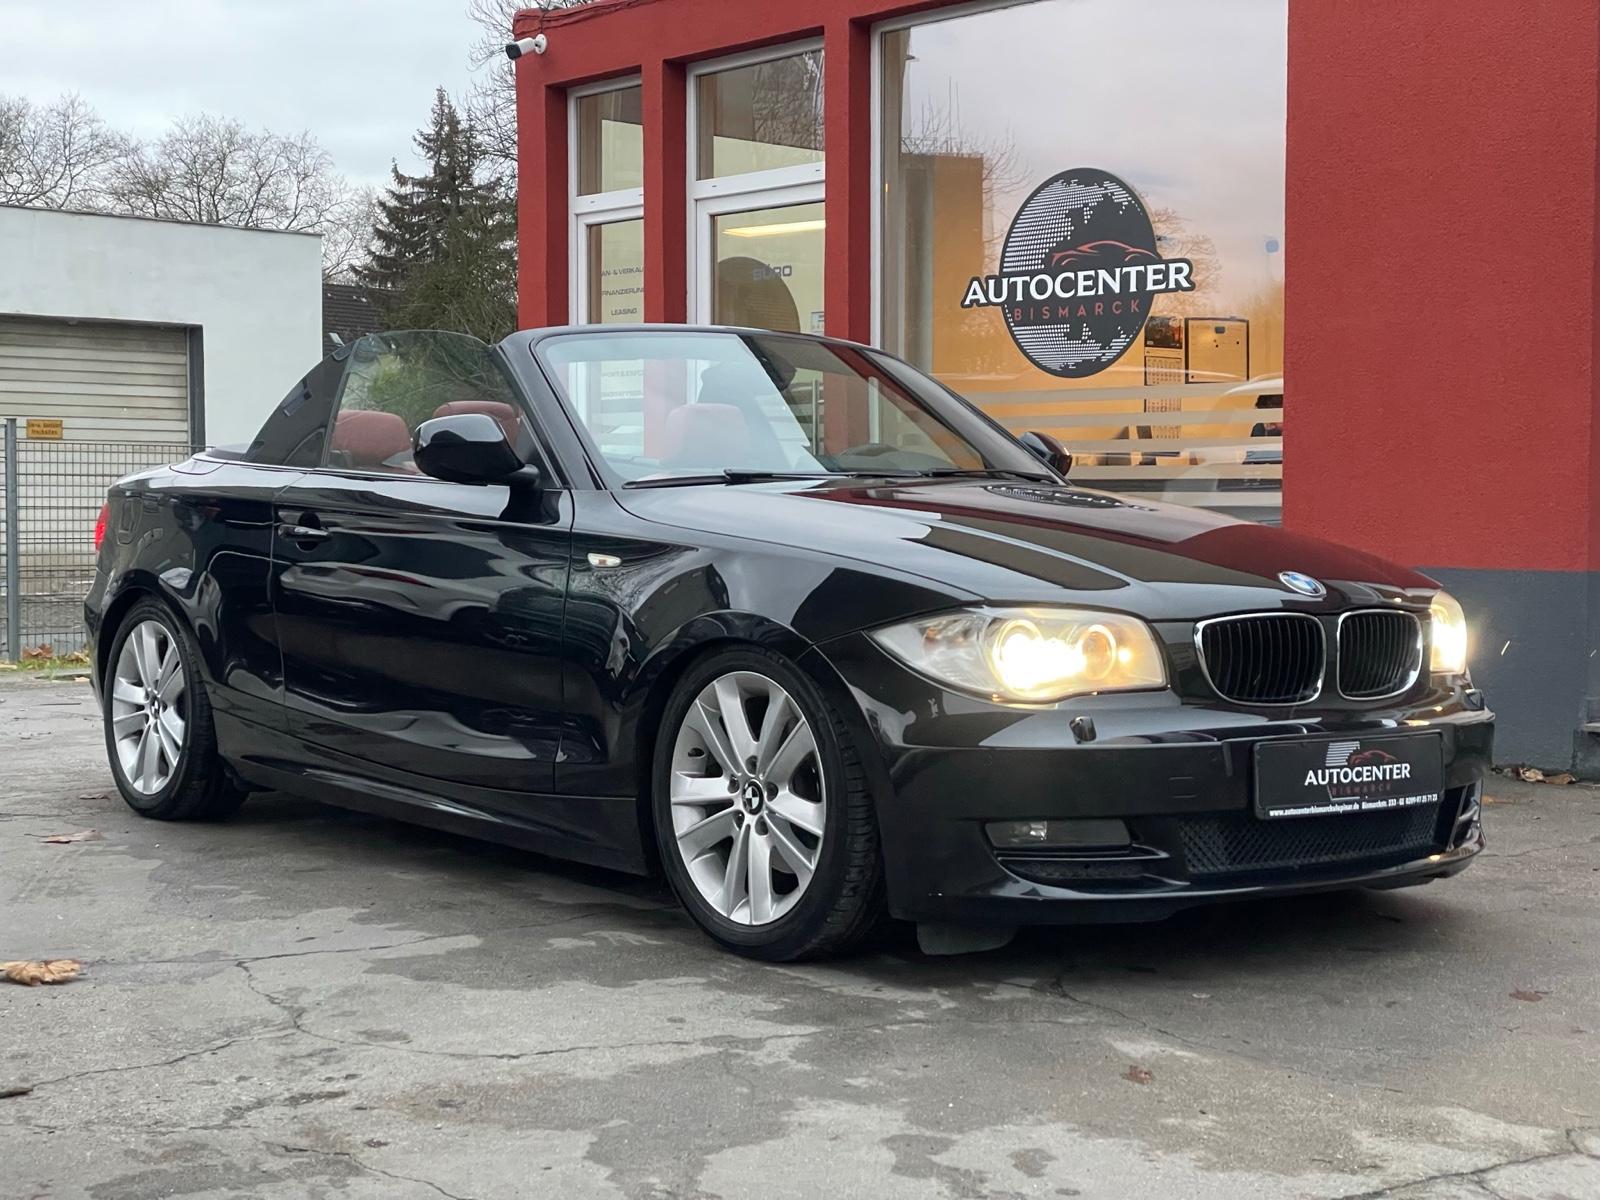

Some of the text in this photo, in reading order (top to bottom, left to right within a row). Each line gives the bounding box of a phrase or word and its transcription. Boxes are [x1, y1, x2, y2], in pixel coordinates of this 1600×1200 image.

[753, 264, 792, 281] BÜRO
[964, 261, 1193, 306] AUTOCENTER
[610, 307, 638, 316] LEASING
[1013, 298, 1141, 322] BISMARCK
[1304, 762, 1411, 787] AUTOCENTER
[1332, 783, 1392, 797] BISMARCK
